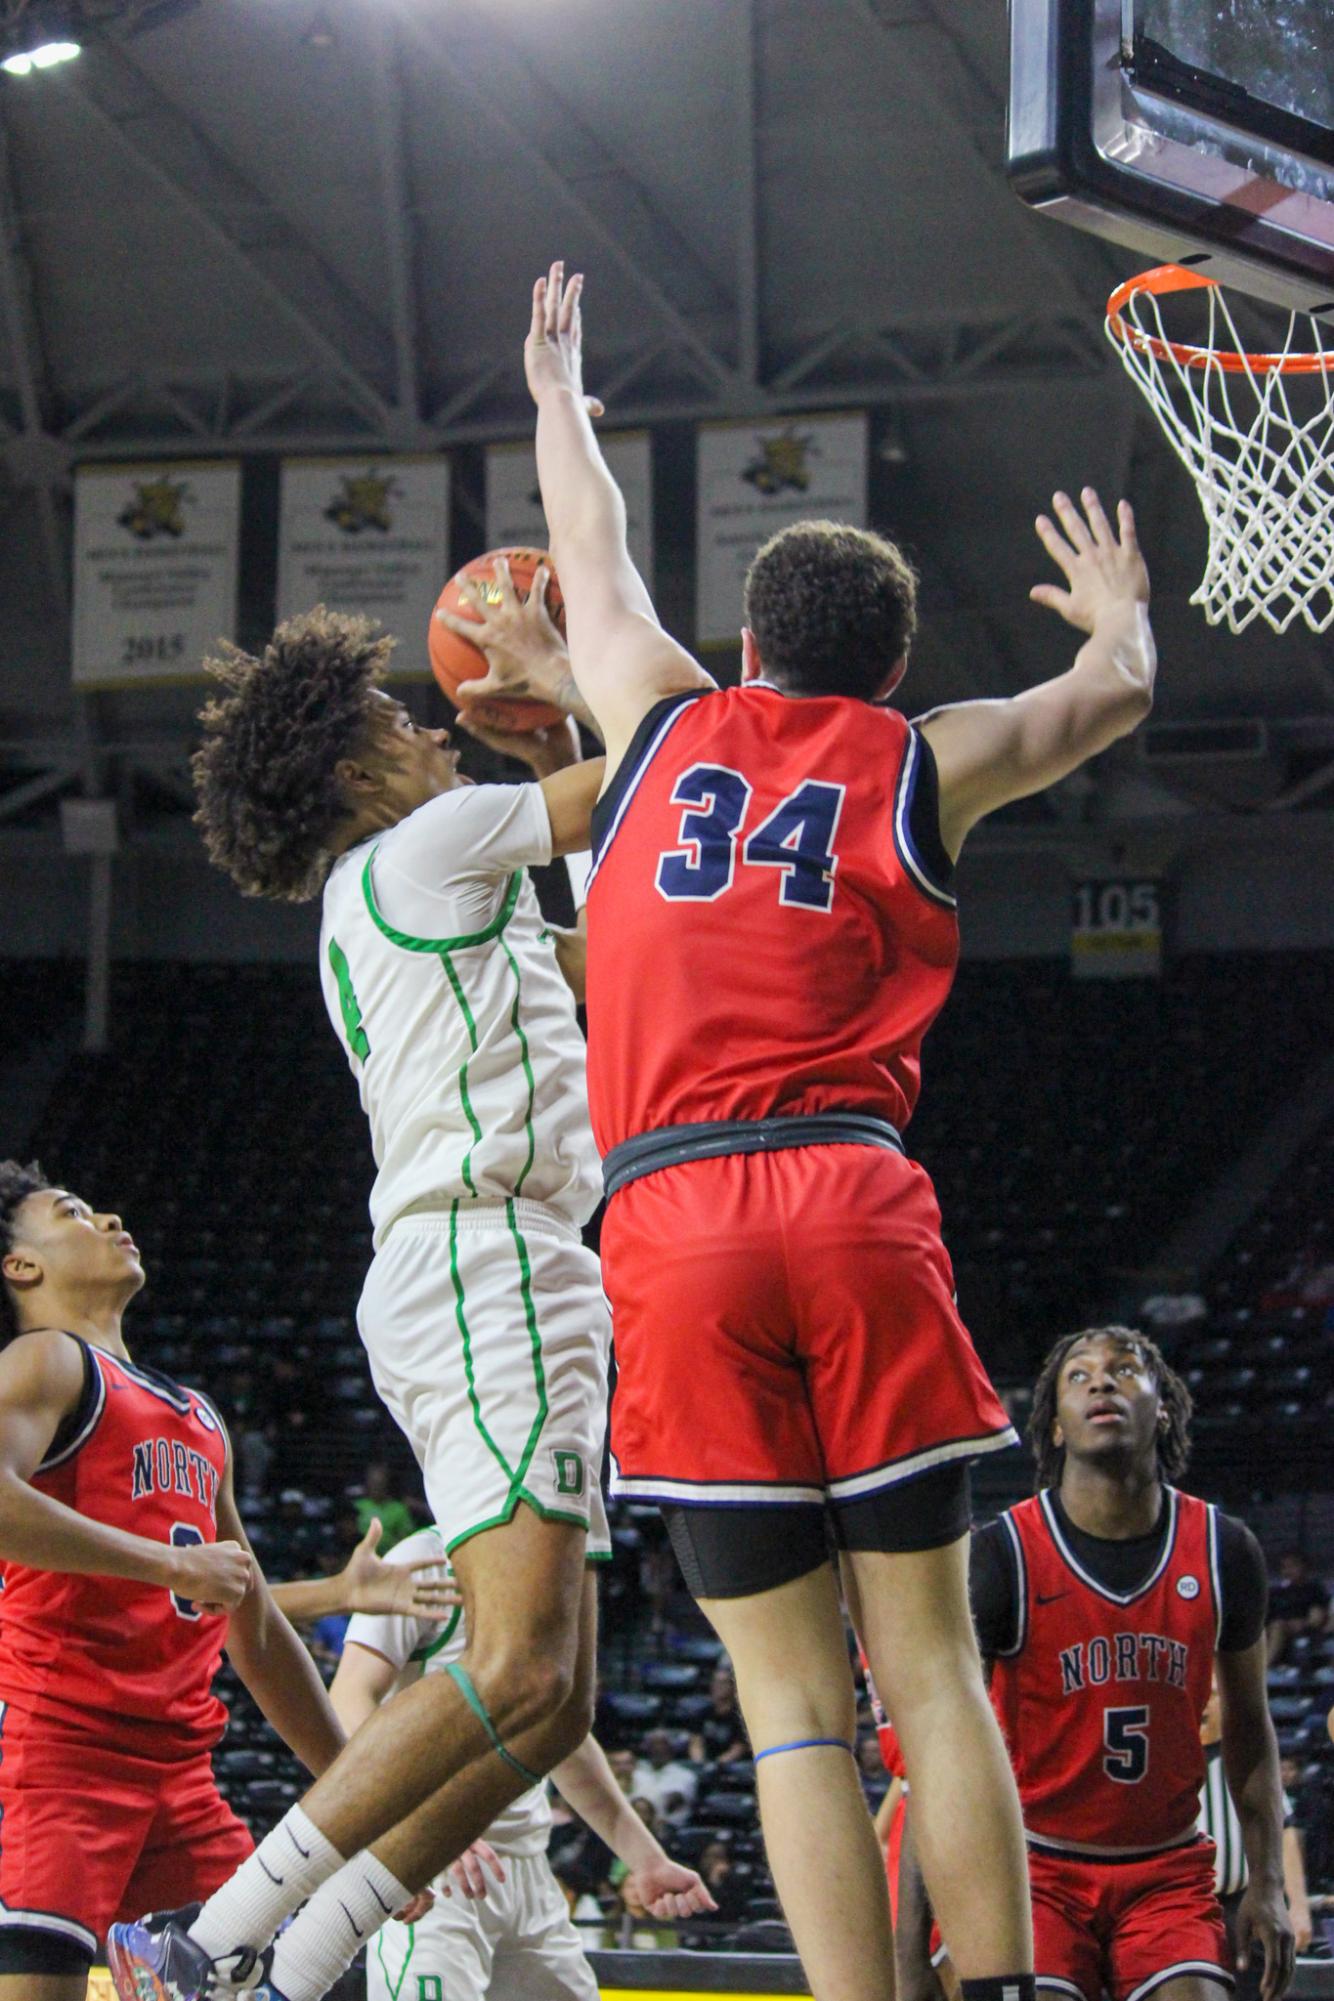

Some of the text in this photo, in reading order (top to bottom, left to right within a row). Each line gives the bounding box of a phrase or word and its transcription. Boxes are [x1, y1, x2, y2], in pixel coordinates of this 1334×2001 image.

[654, 762, 846, 914] 34
[1075, 885, 1159, 931] 105
[551, 1449, 584, 1496] D
[1180, 1581, 1197, 1593] RD
[1059, 1632, 1189, 1696] NORTH
[1103, 1705, 1150, 1784] 5
